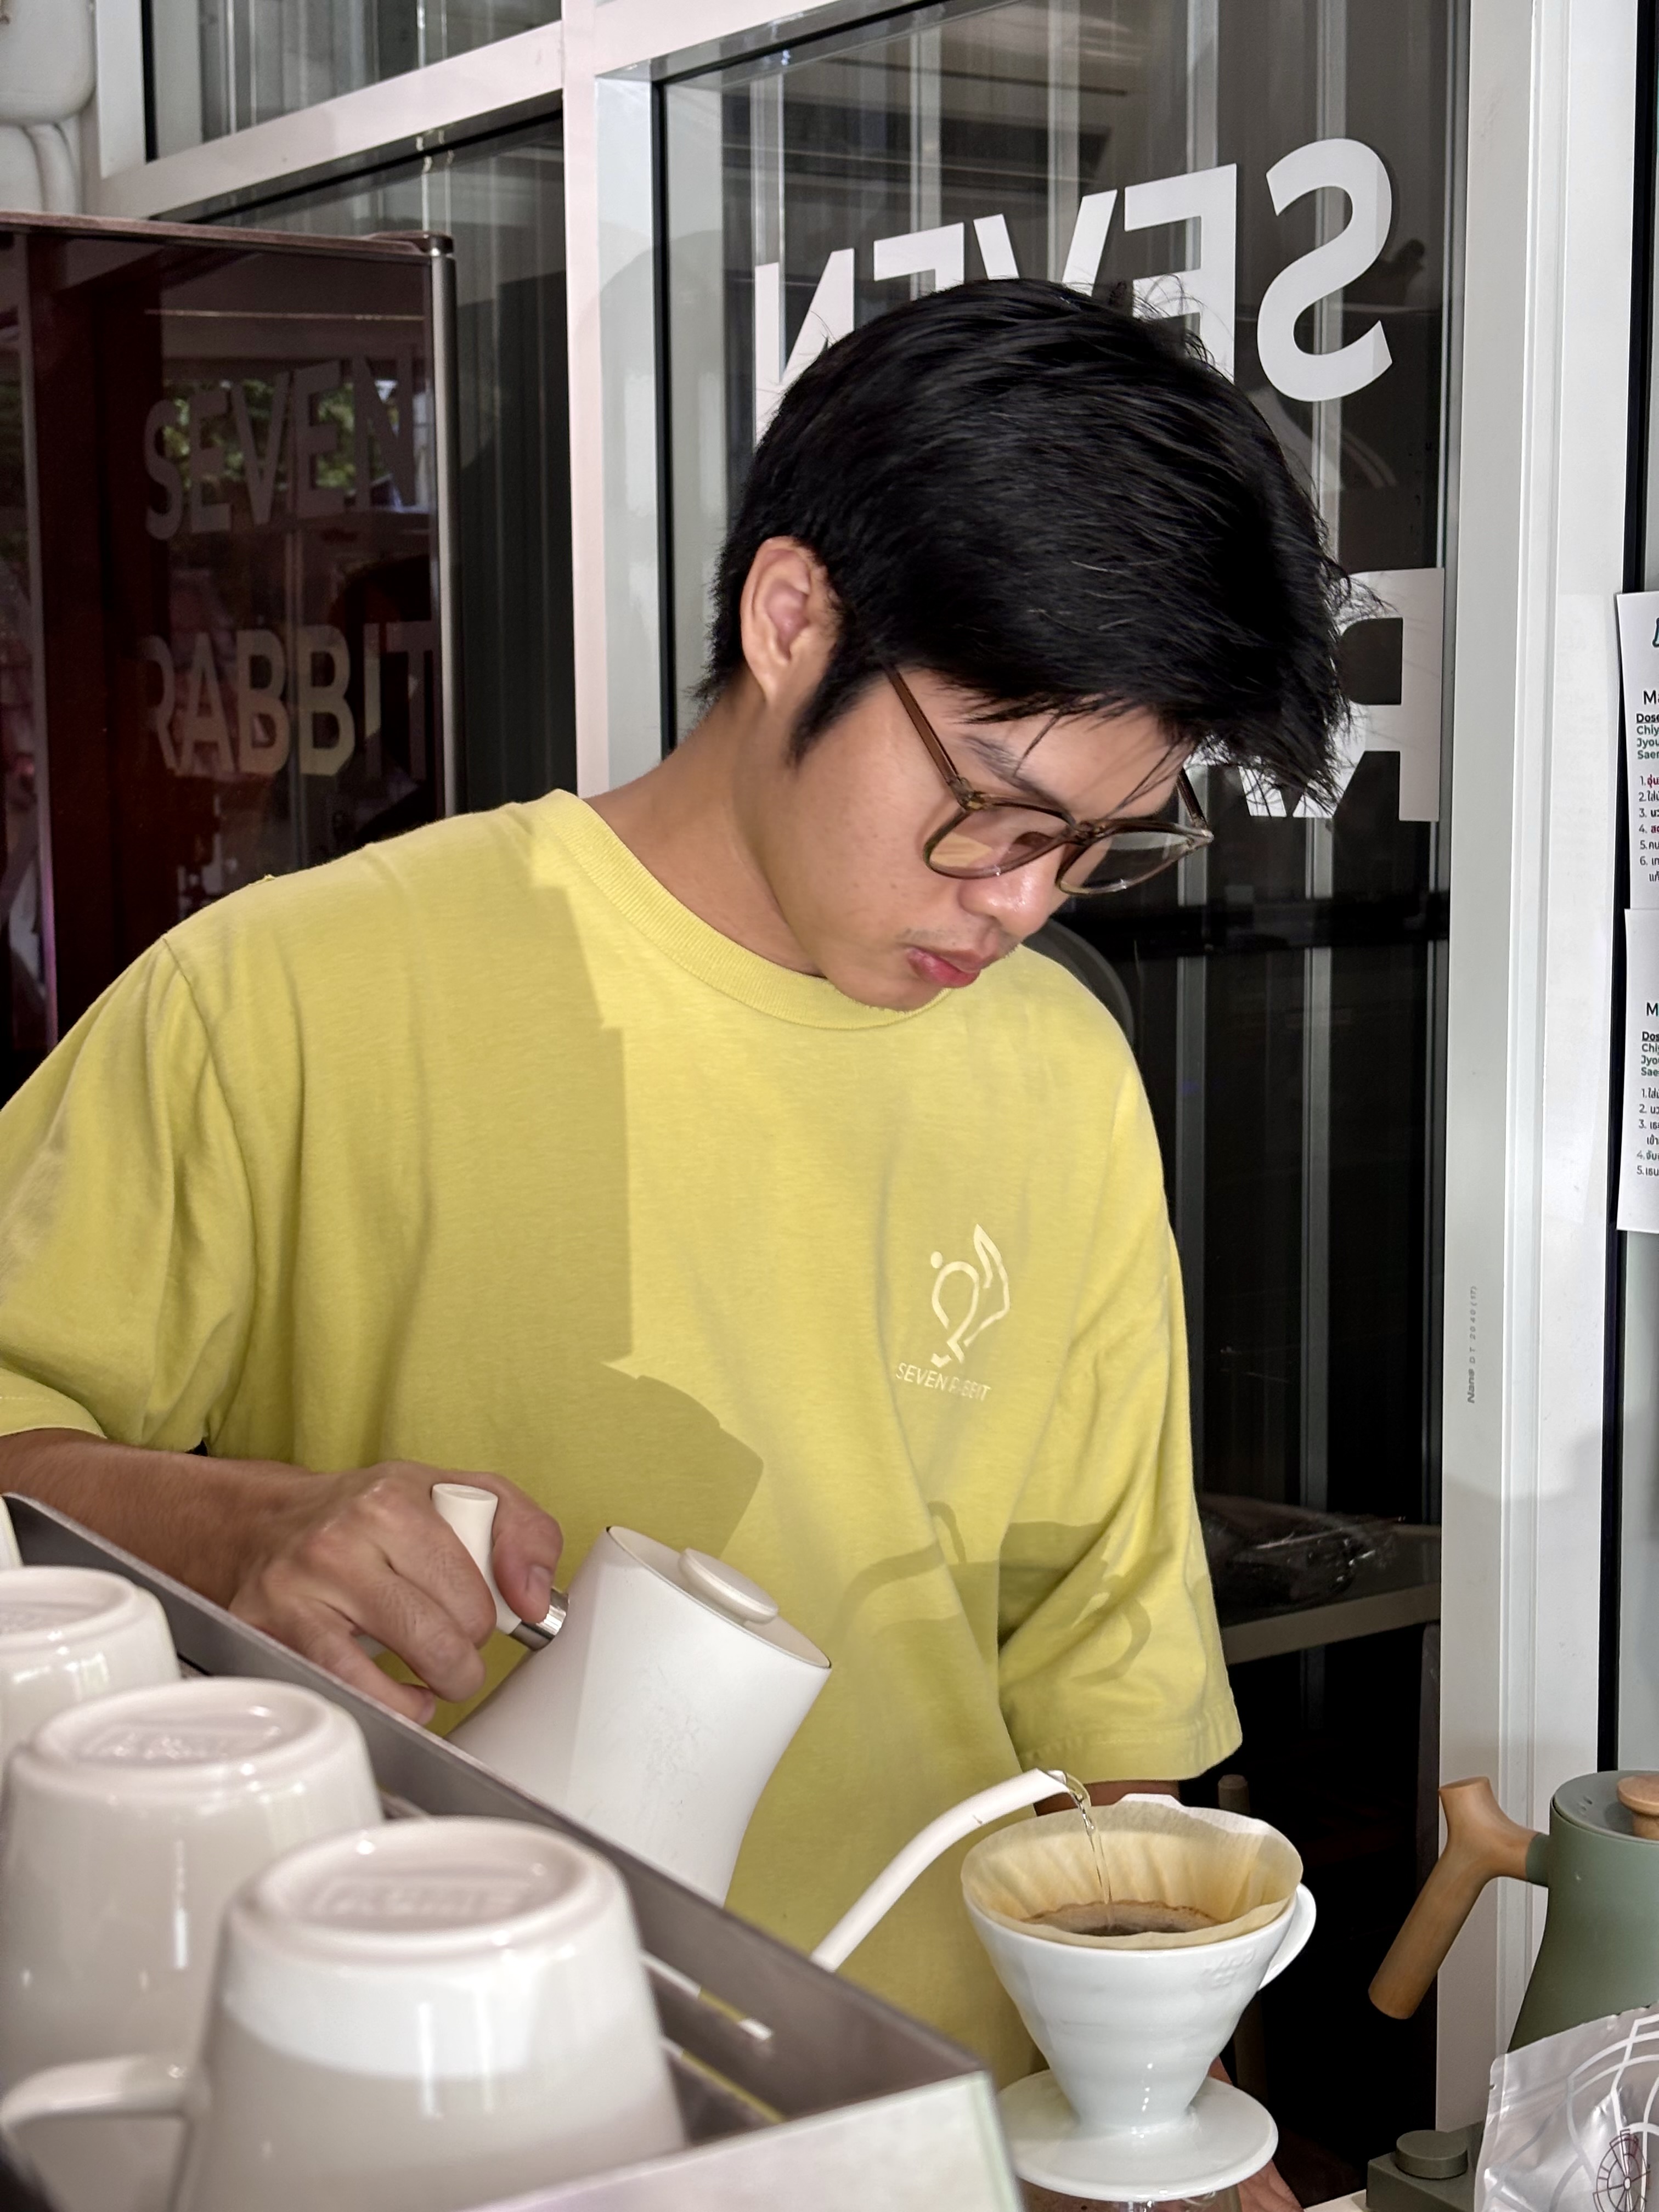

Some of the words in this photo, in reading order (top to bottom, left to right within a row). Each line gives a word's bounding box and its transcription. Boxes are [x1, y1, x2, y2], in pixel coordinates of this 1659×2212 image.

[144, 342, 415, 540] SEVEN
[136, 619, 437, 780] RABBIT
[1643, 690, 1659, 705] M
[1641, 1043, 1659, 1054] Chi
[1641, 1054, 1659, 1066] Jyo
[896, 1362, 949, 1391] SEVEN
